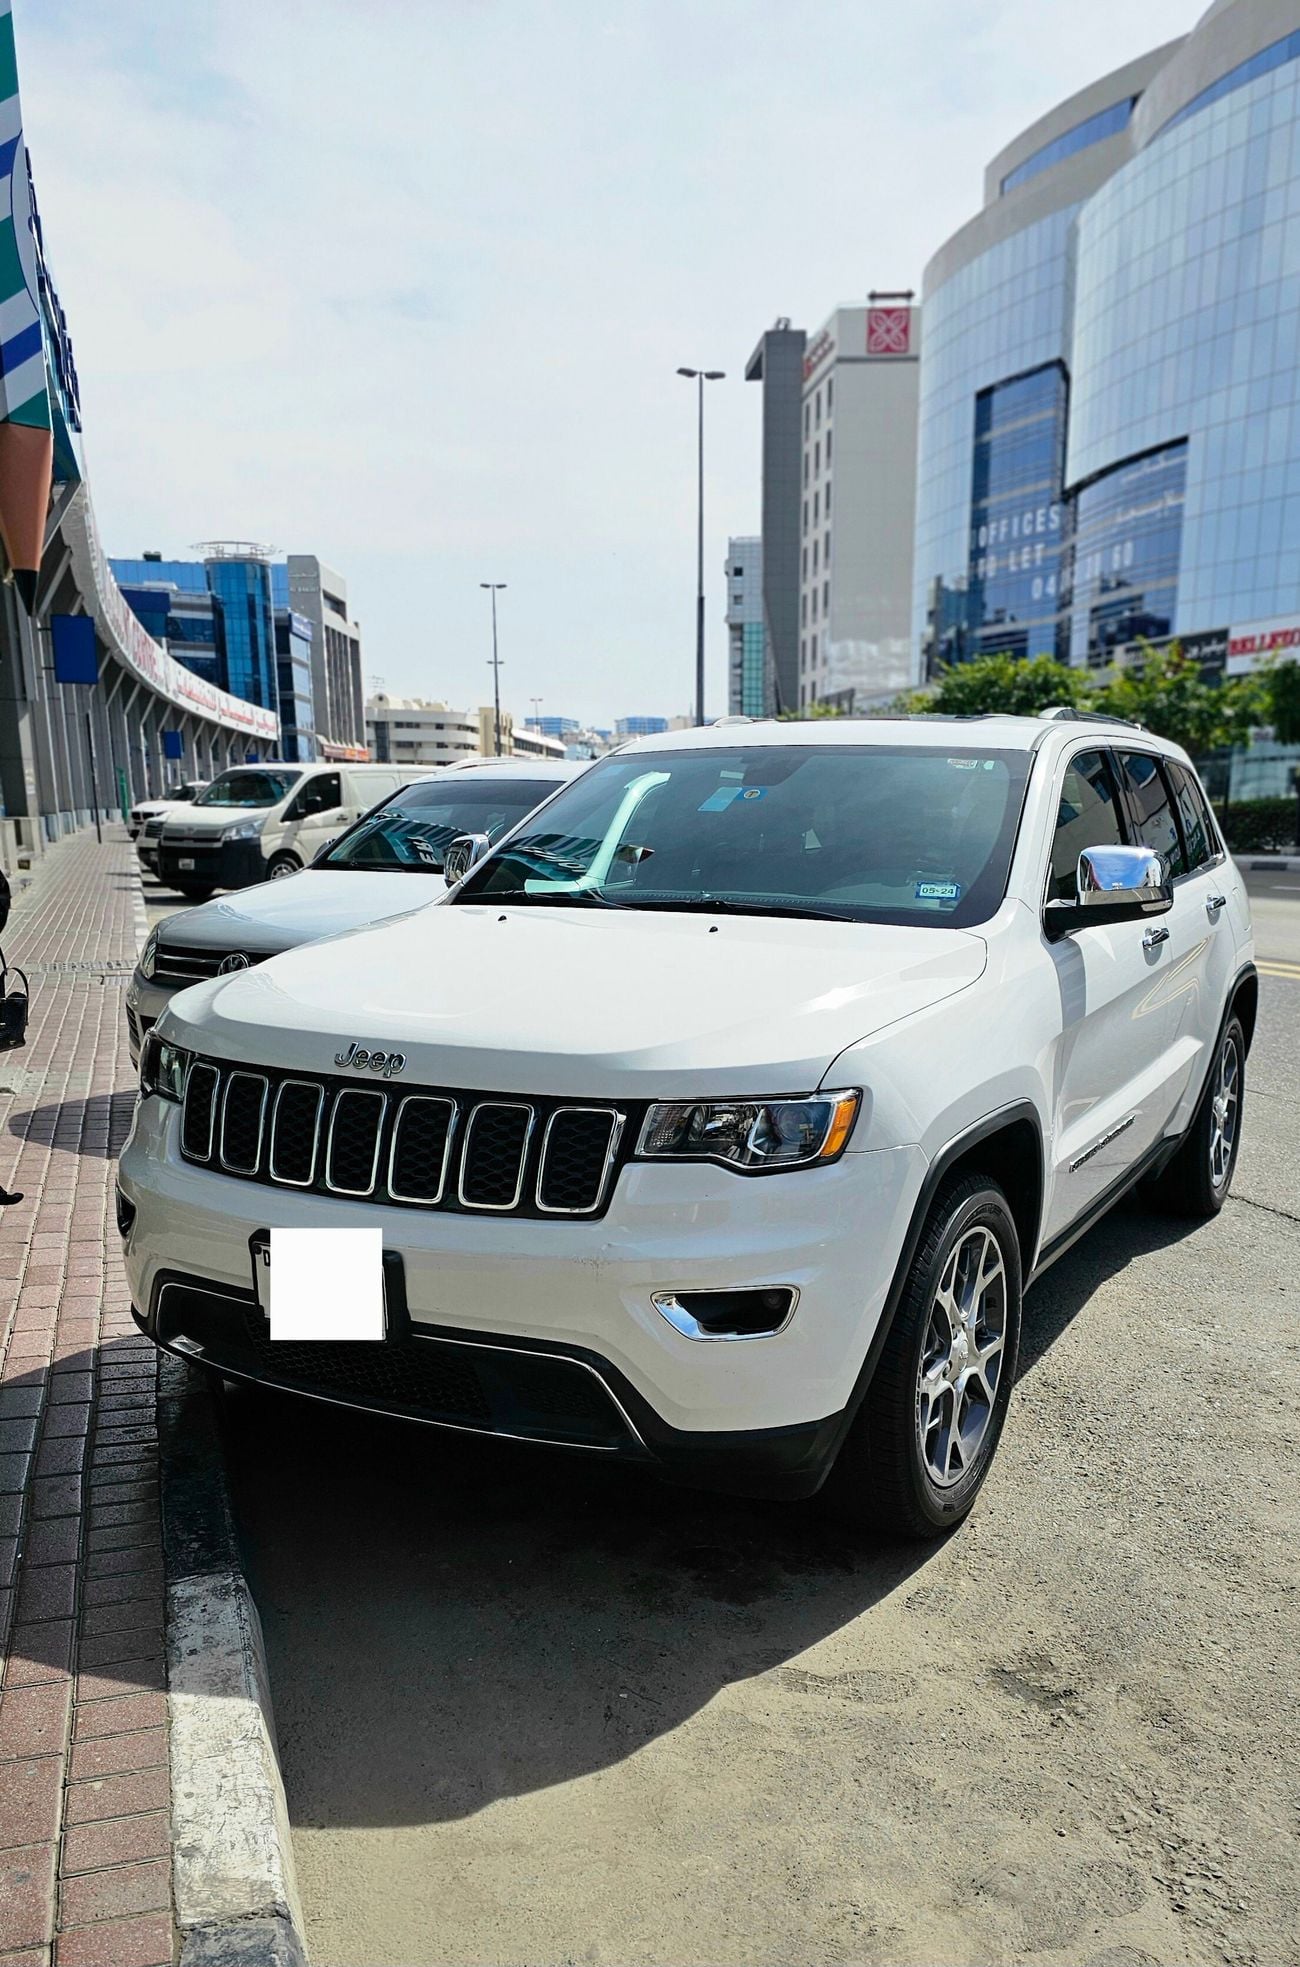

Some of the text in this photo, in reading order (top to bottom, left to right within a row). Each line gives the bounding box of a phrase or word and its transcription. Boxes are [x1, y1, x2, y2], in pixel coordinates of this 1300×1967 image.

[980, 506, 1060, 547] OFFICES
[1010, 544, 1045, 572] LET
[922, 887, 954, 895] 05-24
[334, 1042, 406, 1078] Jeep
